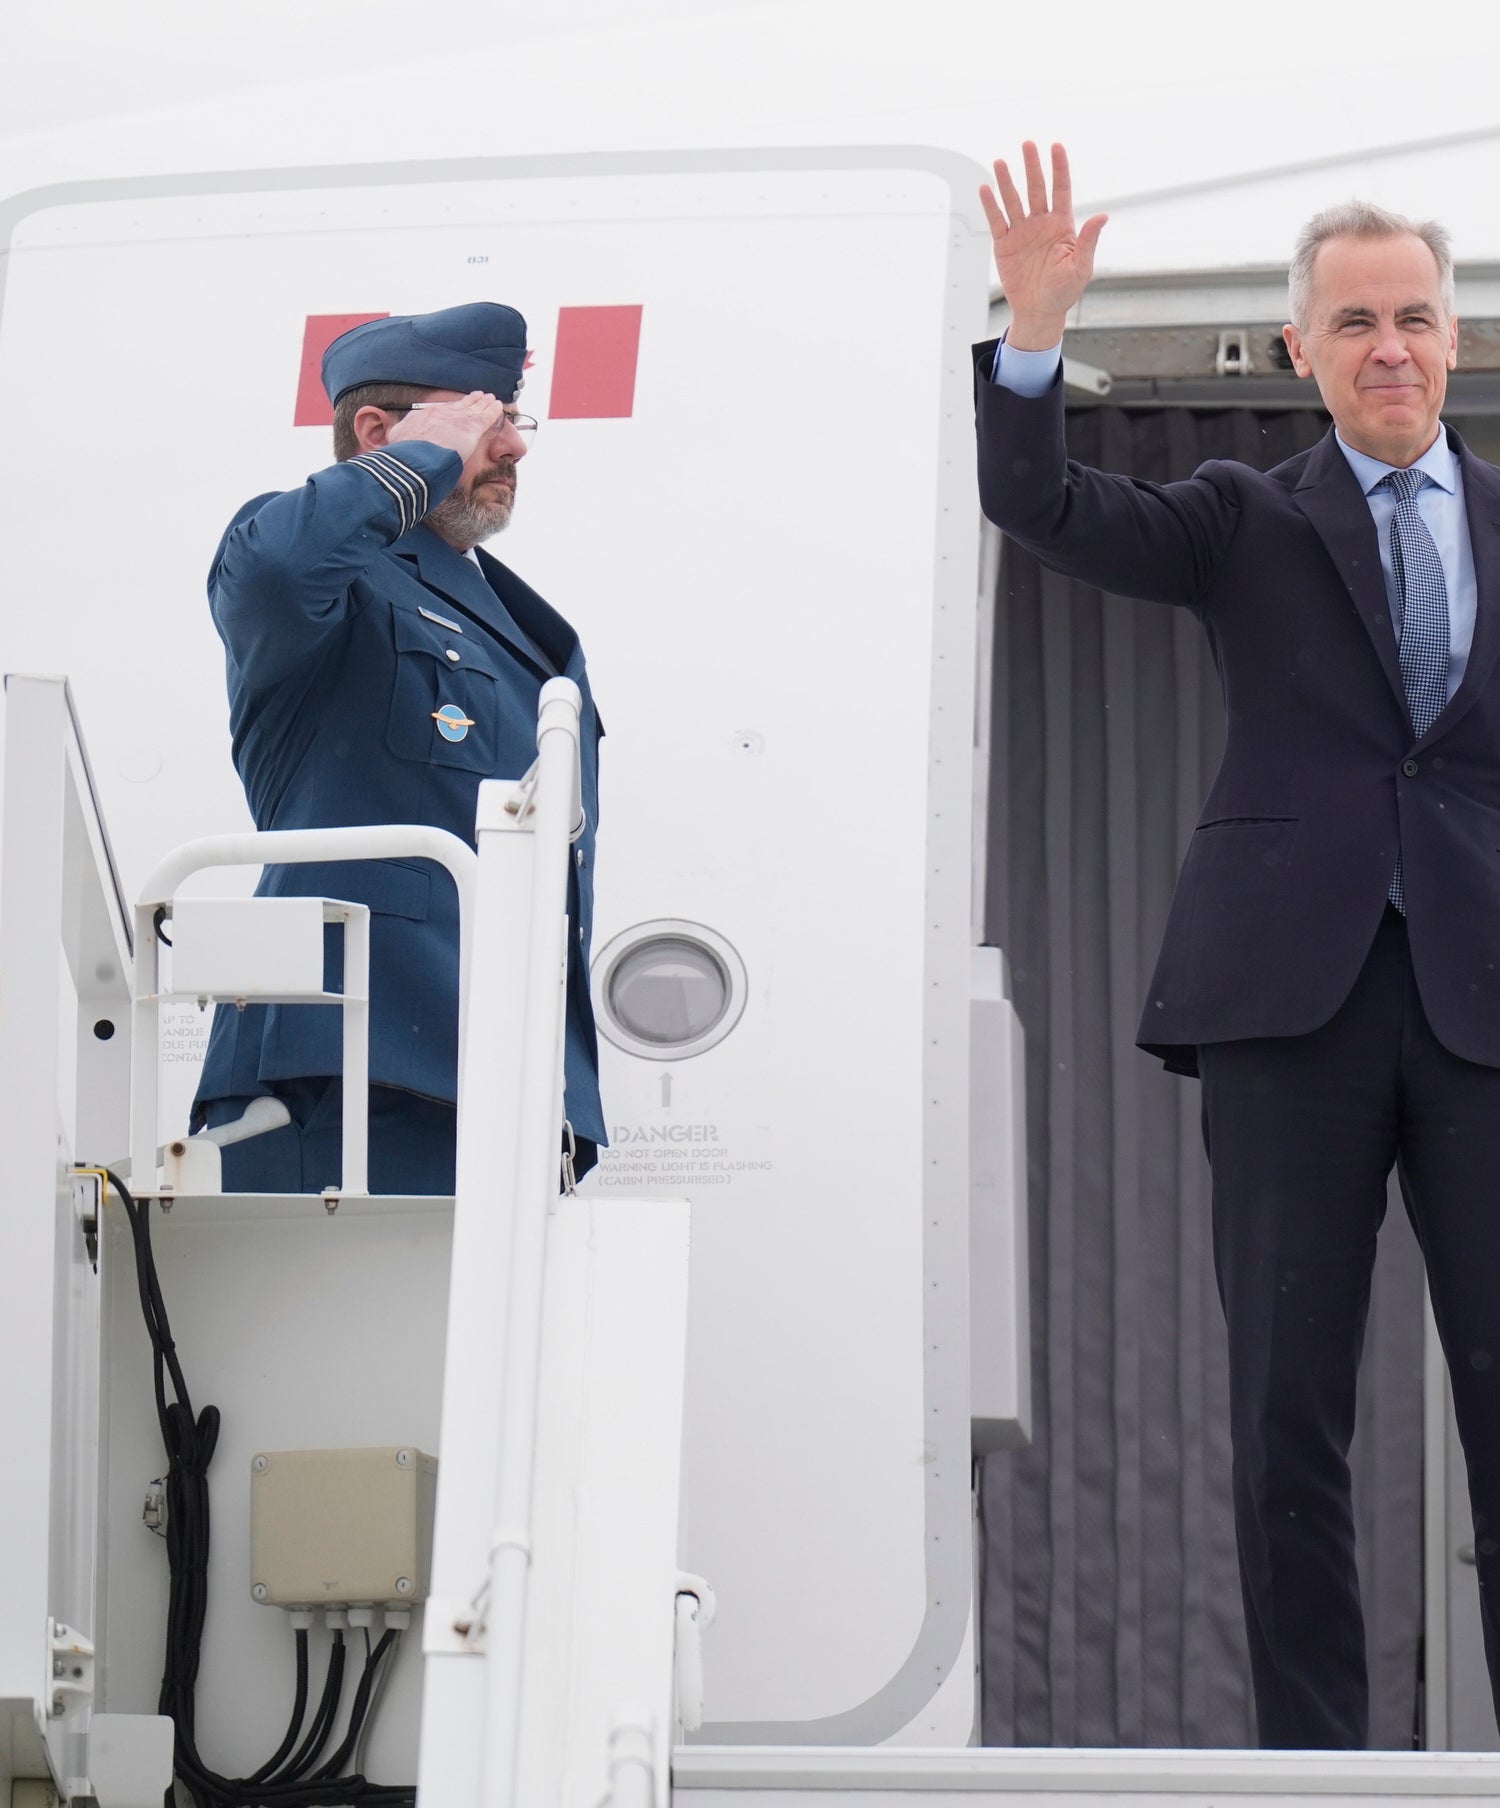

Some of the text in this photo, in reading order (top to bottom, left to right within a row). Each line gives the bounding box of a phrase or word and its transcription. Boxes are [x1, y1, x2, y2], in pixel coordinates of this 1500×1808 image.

[163, 1027, 205, 1037] ANDLE
[613, 1124, 720, 1144] DANGER
[601, 1147, 728, 1160] DO NOT OPEN DOOR
[599, 1161, 773, 1172] WARNING LIGHT IS FLASHING
[597, 1174, 732, 1186] (CABIN PRESSURISED)
